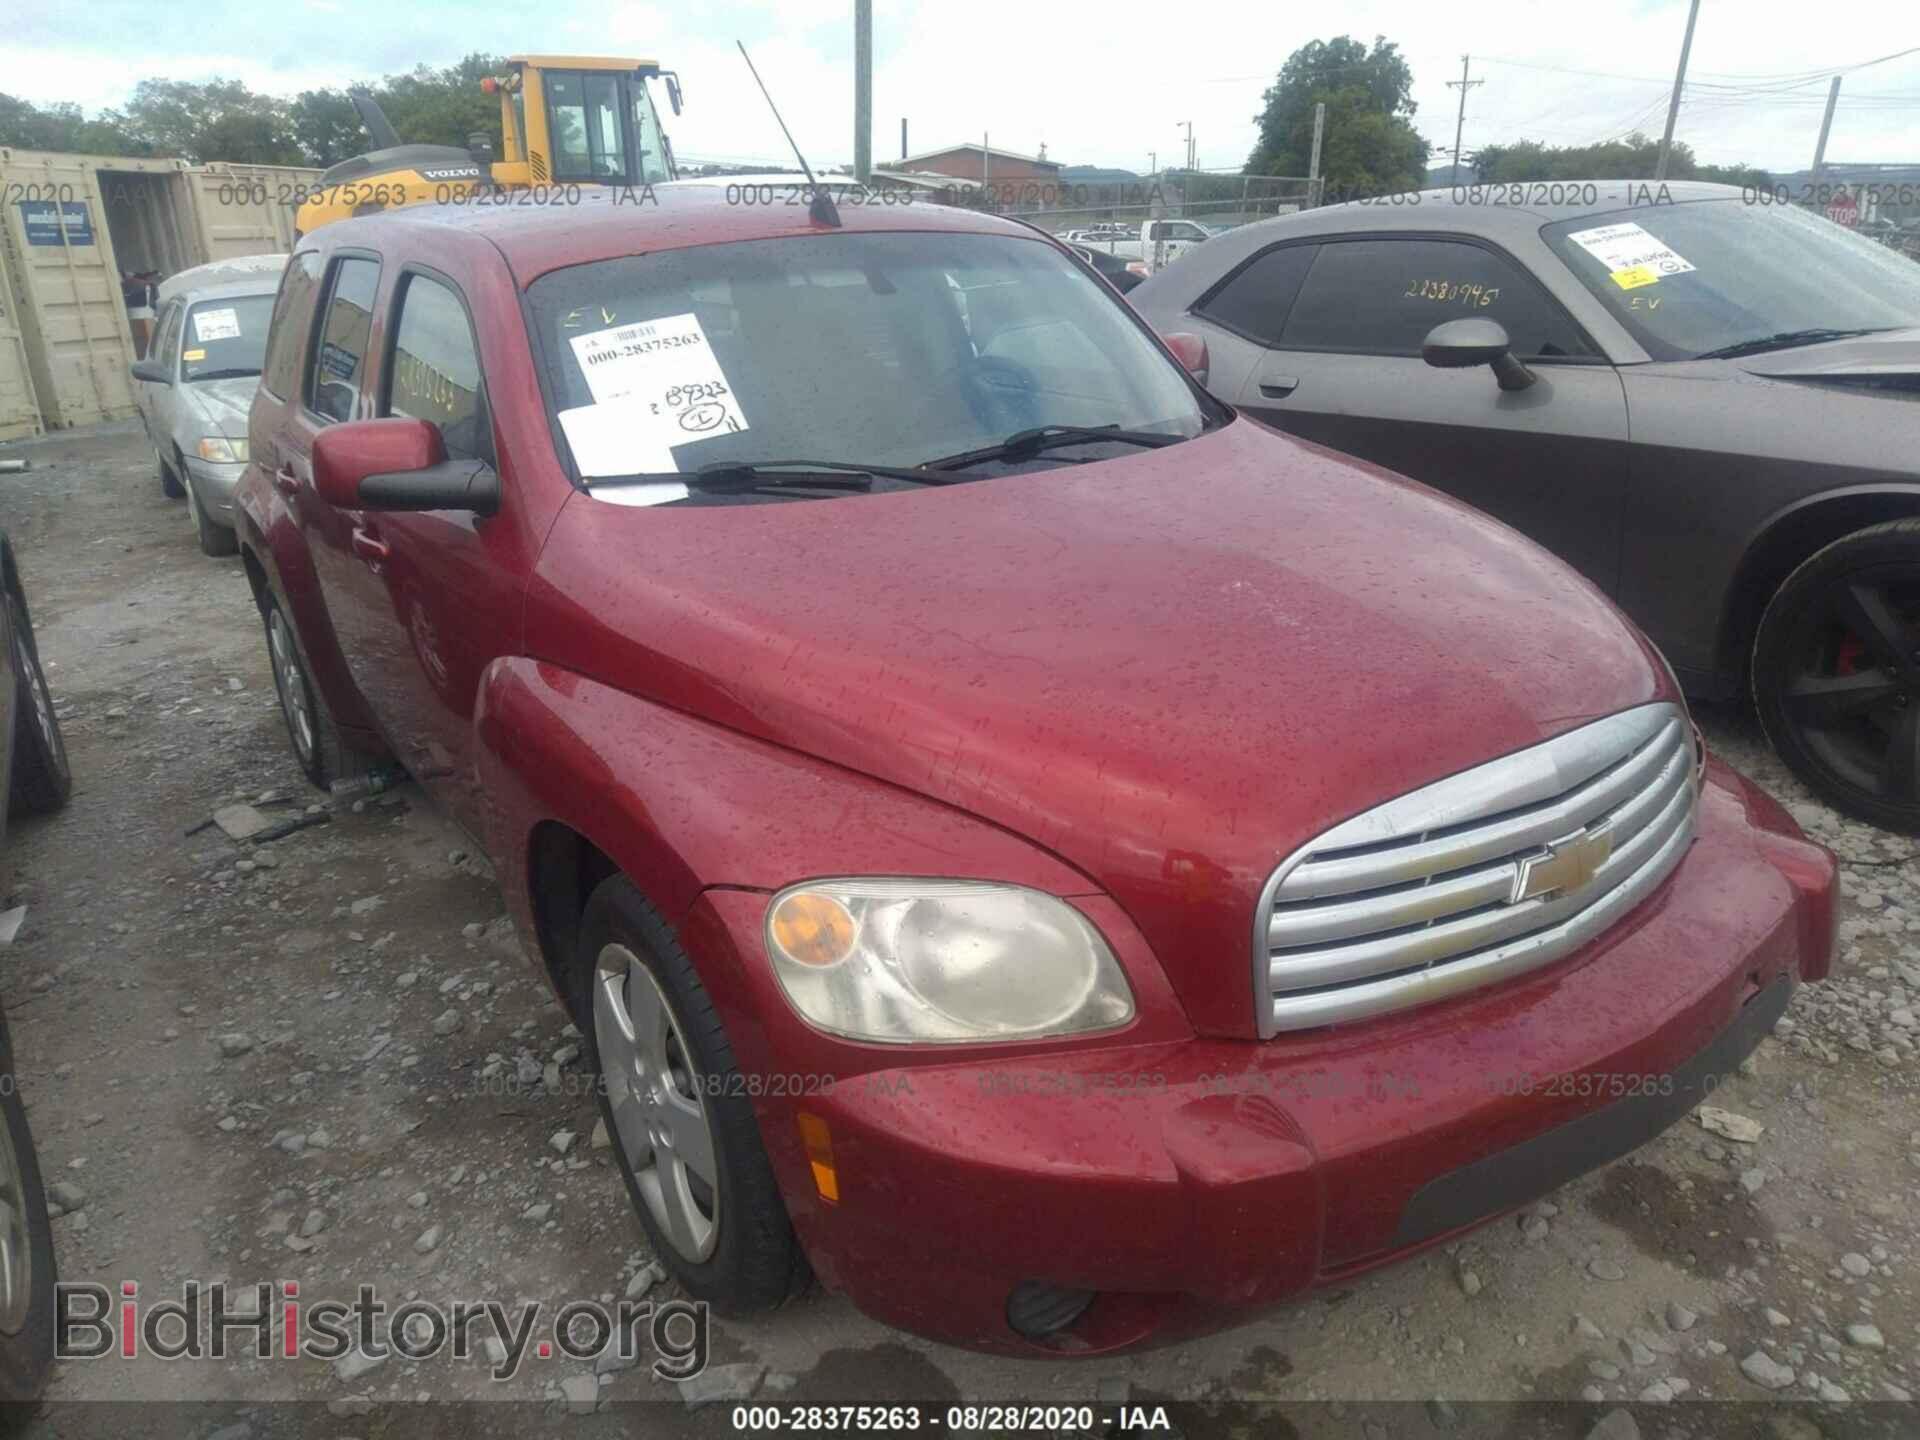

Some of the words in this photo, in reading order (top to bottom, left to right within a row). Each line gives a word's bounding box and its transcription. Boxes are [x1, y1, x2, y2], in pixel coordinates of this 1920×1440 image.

[424, 168, 480, 178] VOLVO
[1826, 207, 1857, 224] STOP
[587, 333, 701, 366] 000-28375263
